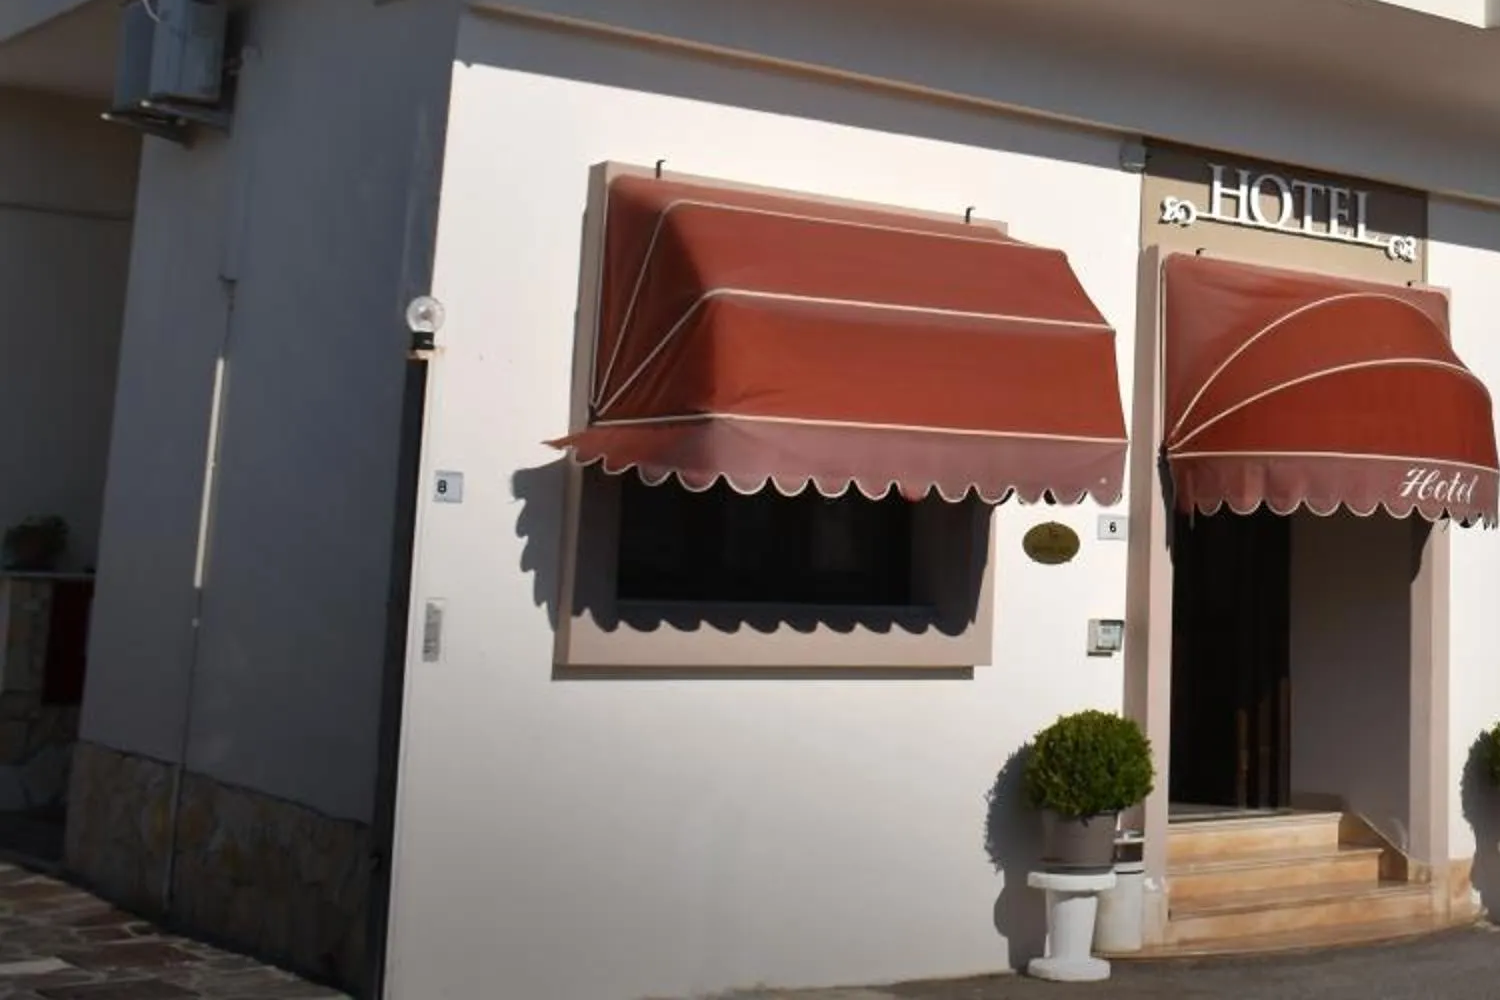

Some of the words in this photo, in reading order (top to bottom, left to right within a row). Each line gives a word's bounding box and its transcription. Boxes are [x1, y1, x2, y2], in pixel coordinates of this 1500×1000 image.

[1208, 163, 1378, 241] HOTEL
[437, 479, 448, 495] 8
[1400, 467, 1480, 504] Hotel
[1109, 521, 1118, 534] 6
